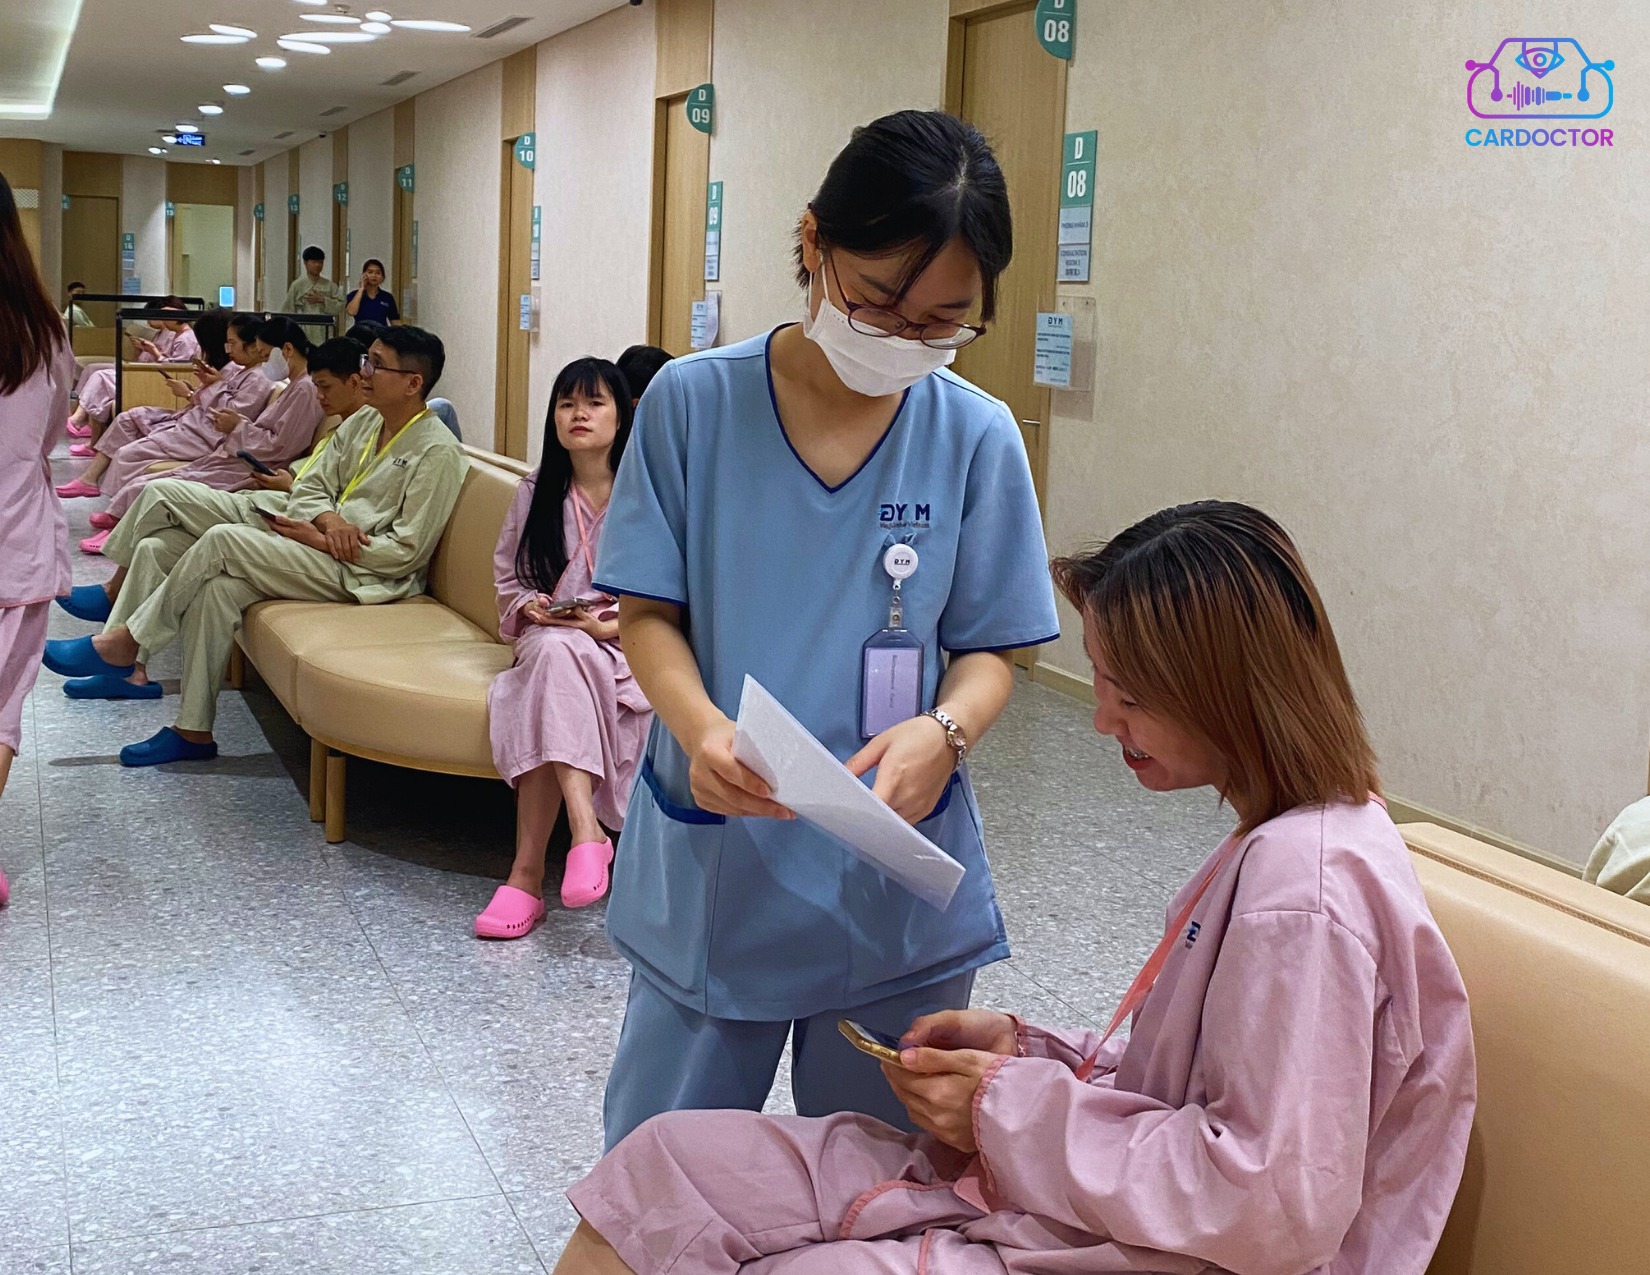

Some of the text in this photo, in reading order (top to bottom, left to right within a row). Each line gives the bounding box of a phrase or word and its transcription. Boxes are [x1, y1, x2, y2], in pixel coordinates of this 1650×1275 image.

[1044, 19, 1069, 42] 08
[699, 89, 706, 100] D
[692, 108, 710, 123] 09
[524, 136, 530, 145] D
[1075, 137, 1083, 159] D
[519, 150, 533, 161] 10
[402, 178, 412, 187] 11
[1068, 170, 1086, 198] 08
[337, 193, 347, 201] 12
